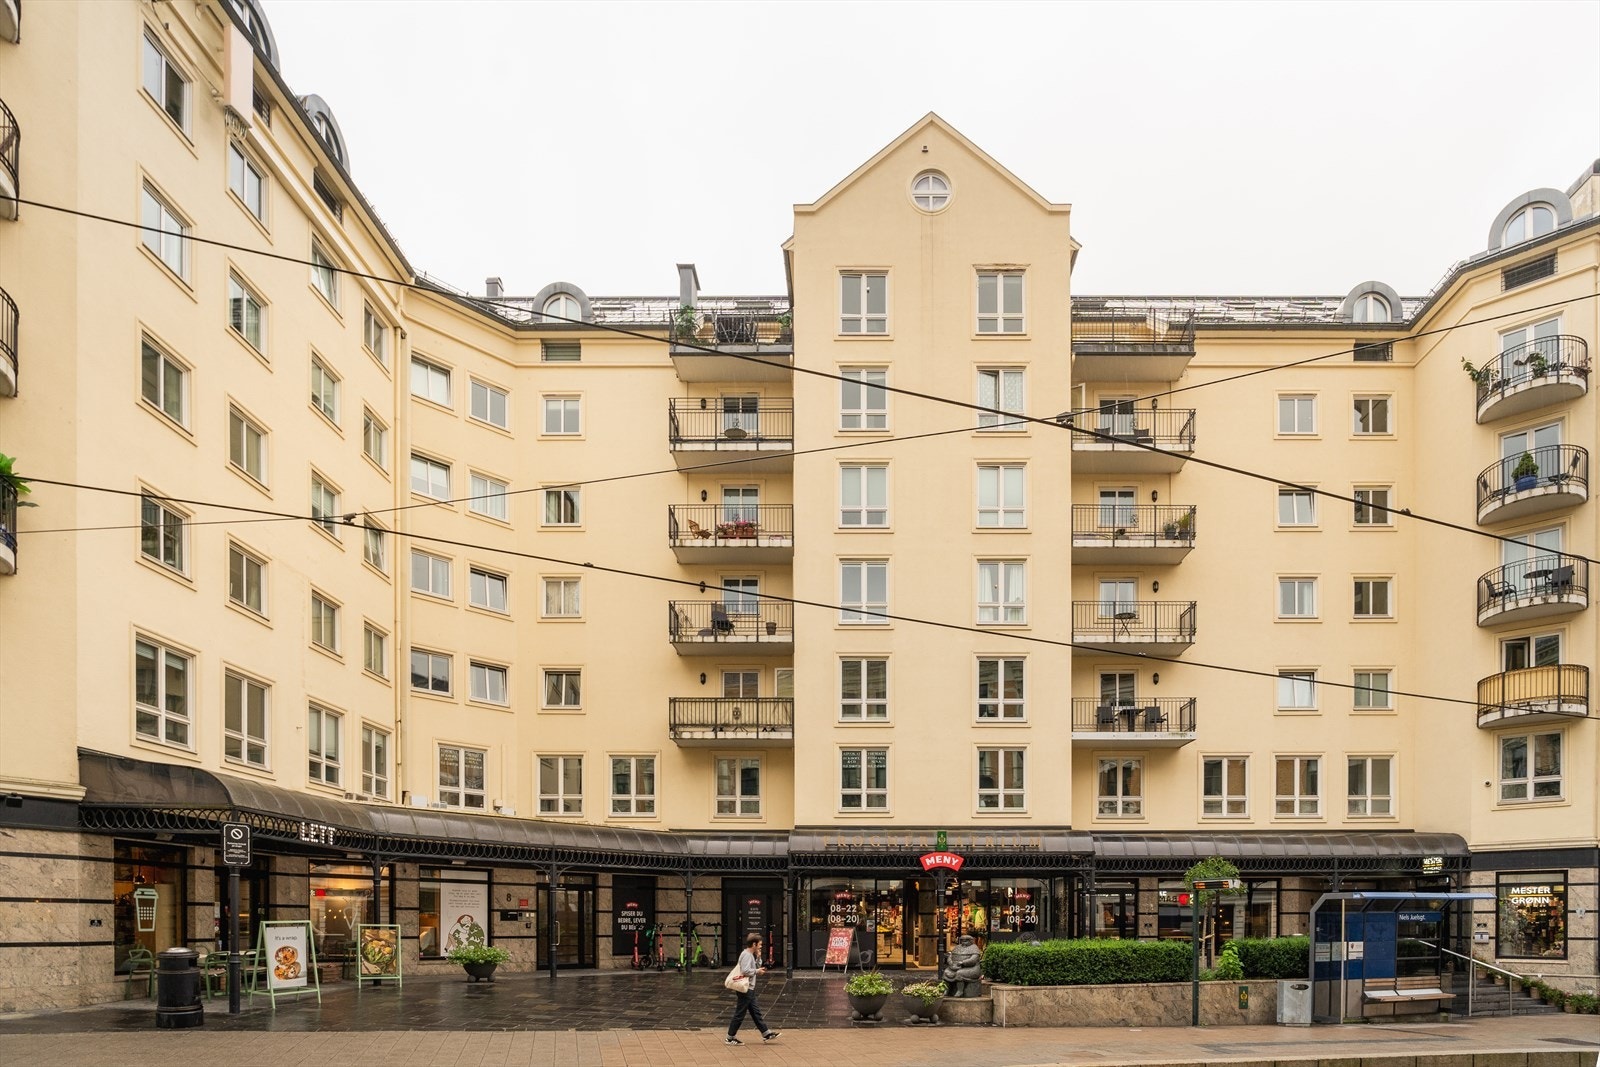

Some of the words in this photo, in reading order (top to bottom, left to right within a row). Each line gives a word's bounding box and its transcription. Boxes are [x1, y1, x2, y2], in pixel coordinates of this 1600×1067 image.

[301, 821, 335, 845] LETT
[925, 855, 959, 866] MENY
[1510, 886, 1551, 894] MESTER
[506, 893, 512, 902] 8
